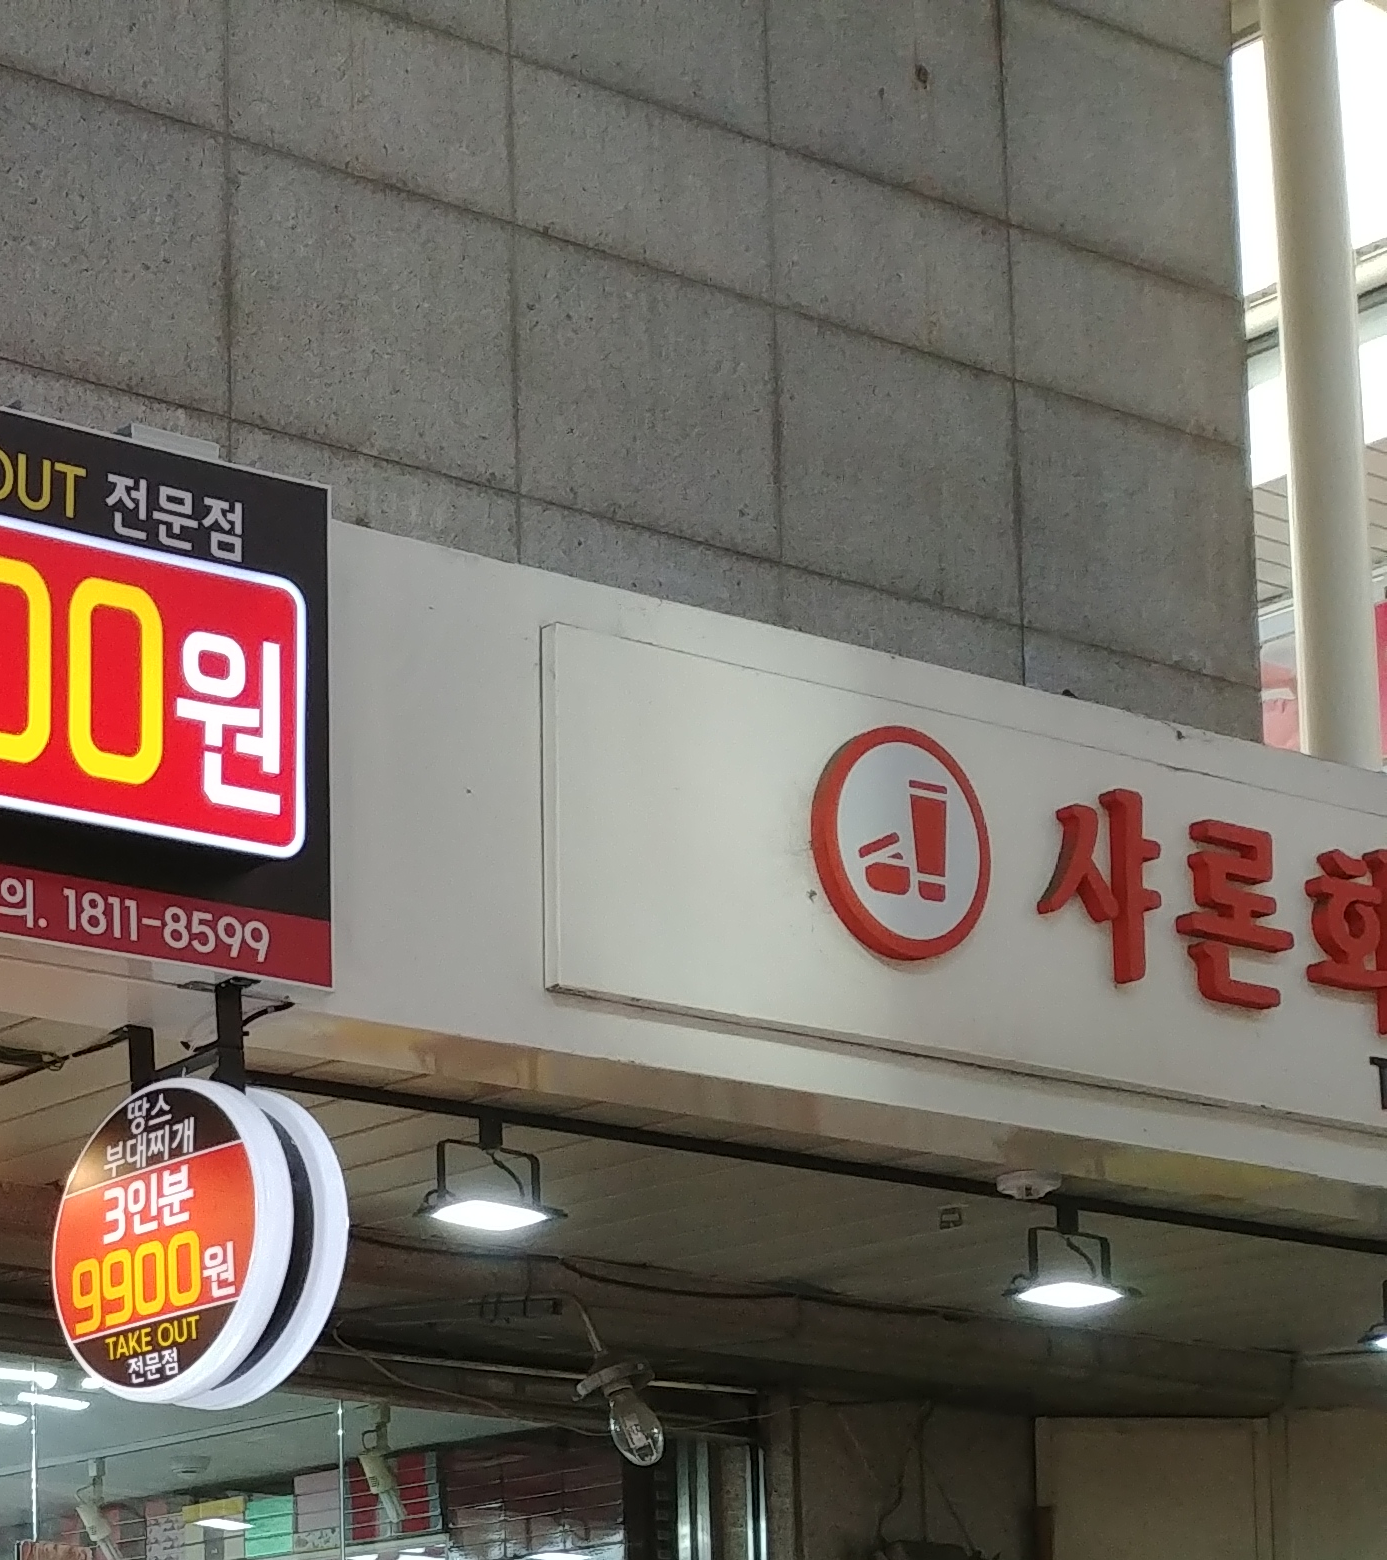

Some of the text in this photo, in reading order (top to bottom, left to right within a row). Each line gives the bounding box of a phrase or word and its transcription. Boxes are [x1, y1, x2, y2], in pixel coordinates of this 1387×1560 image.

[104, 471, 247, 567] 전문점
[62, 887, 272, 967] 1811-8599
[126, 1092, 173, 1136] 땅스
[102, 1116, 196, 1178] 부대찌개
[102, 1164, 195, 1246] 3인분
[104, 1314, 201, 1362] TAKE OUT
[127, 1347, 179, 1384] 전문점
